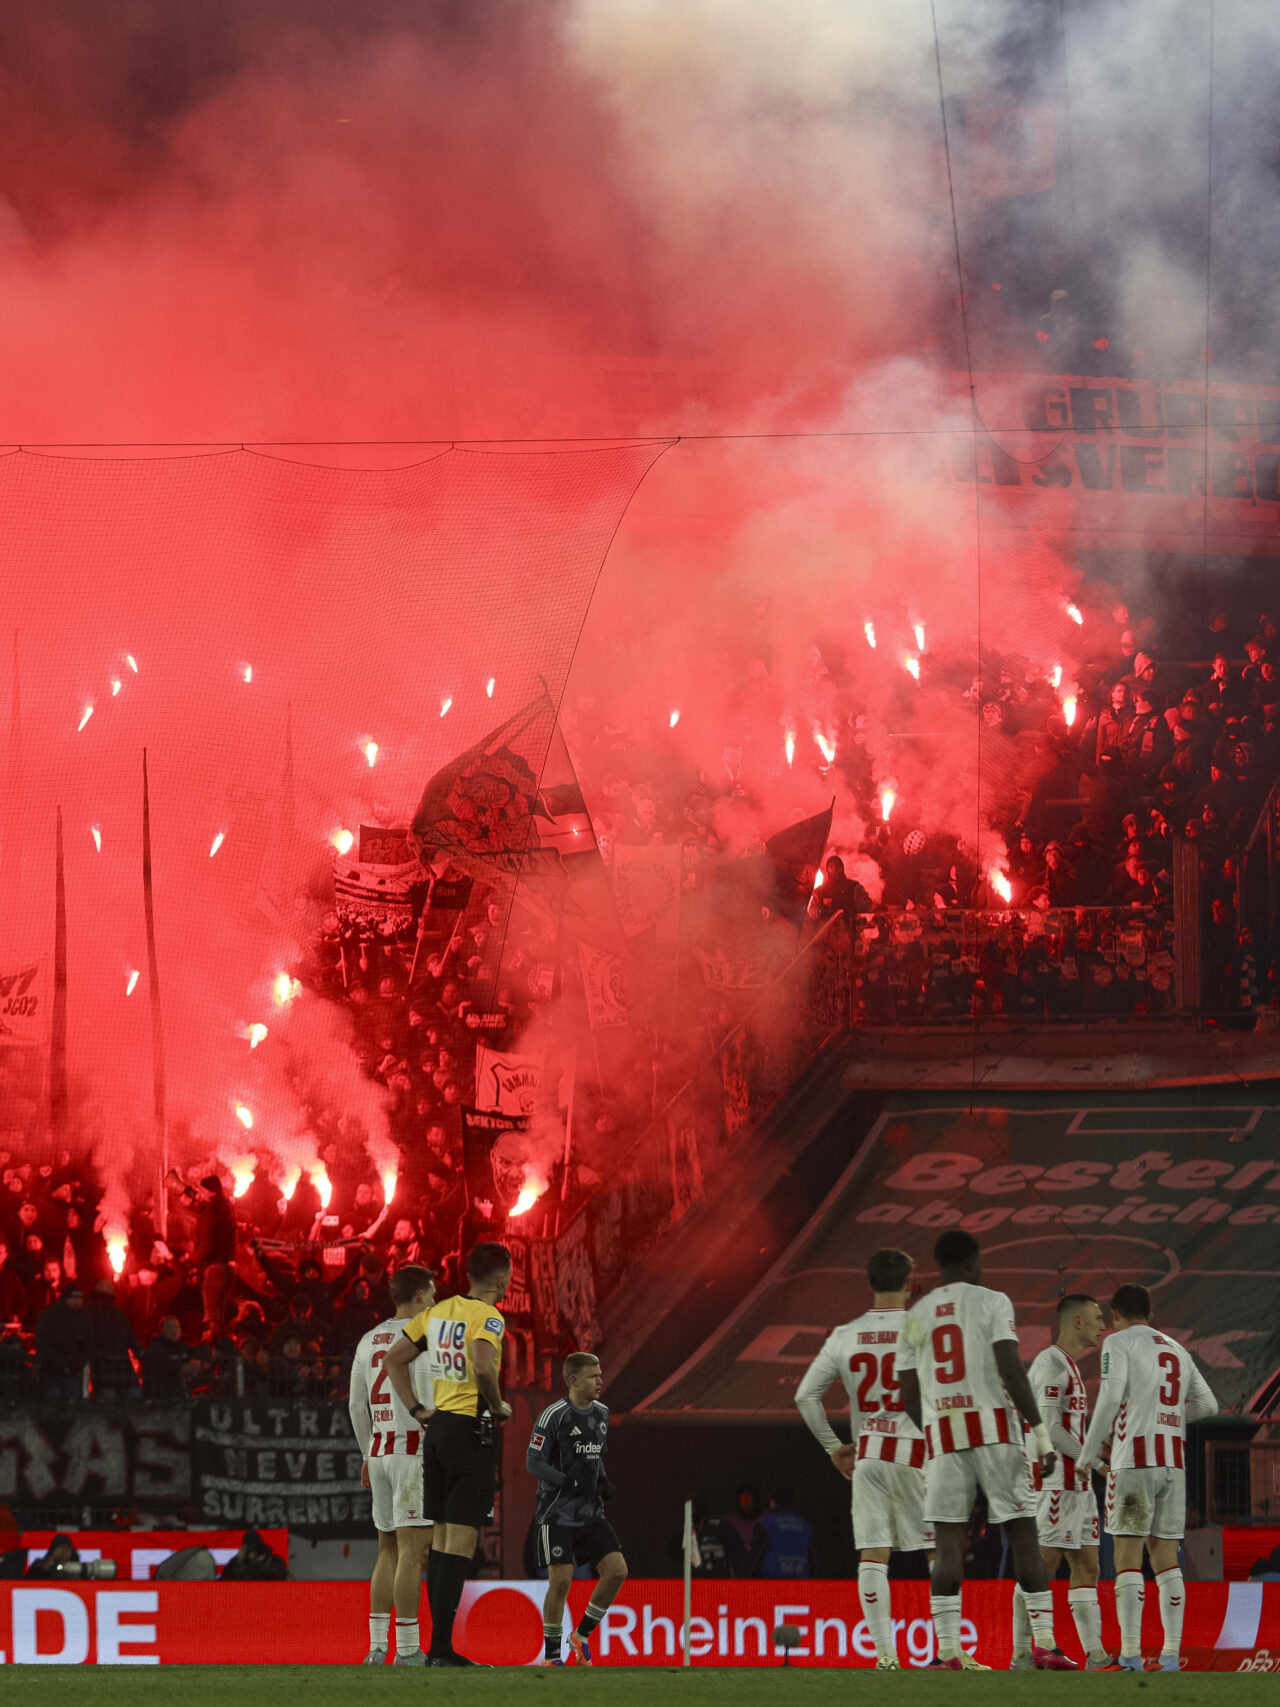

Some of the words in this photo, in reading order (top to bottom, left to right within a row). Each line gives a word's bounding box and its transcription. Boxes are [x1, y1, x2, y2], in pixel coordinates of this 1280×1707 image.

[856, 1196, 1280, 1233] abgesiche
[857, 1331, 899, 1345] THIELMAN
[932, 1323, 966, 1384] 9
[849, 1351, 906, 1412] 29
[1158, 1351, 1180, 1406] 3
[1070, 1397, 1085, 1411] RE
[202, 1488, 370, 1524] SURRENDE
